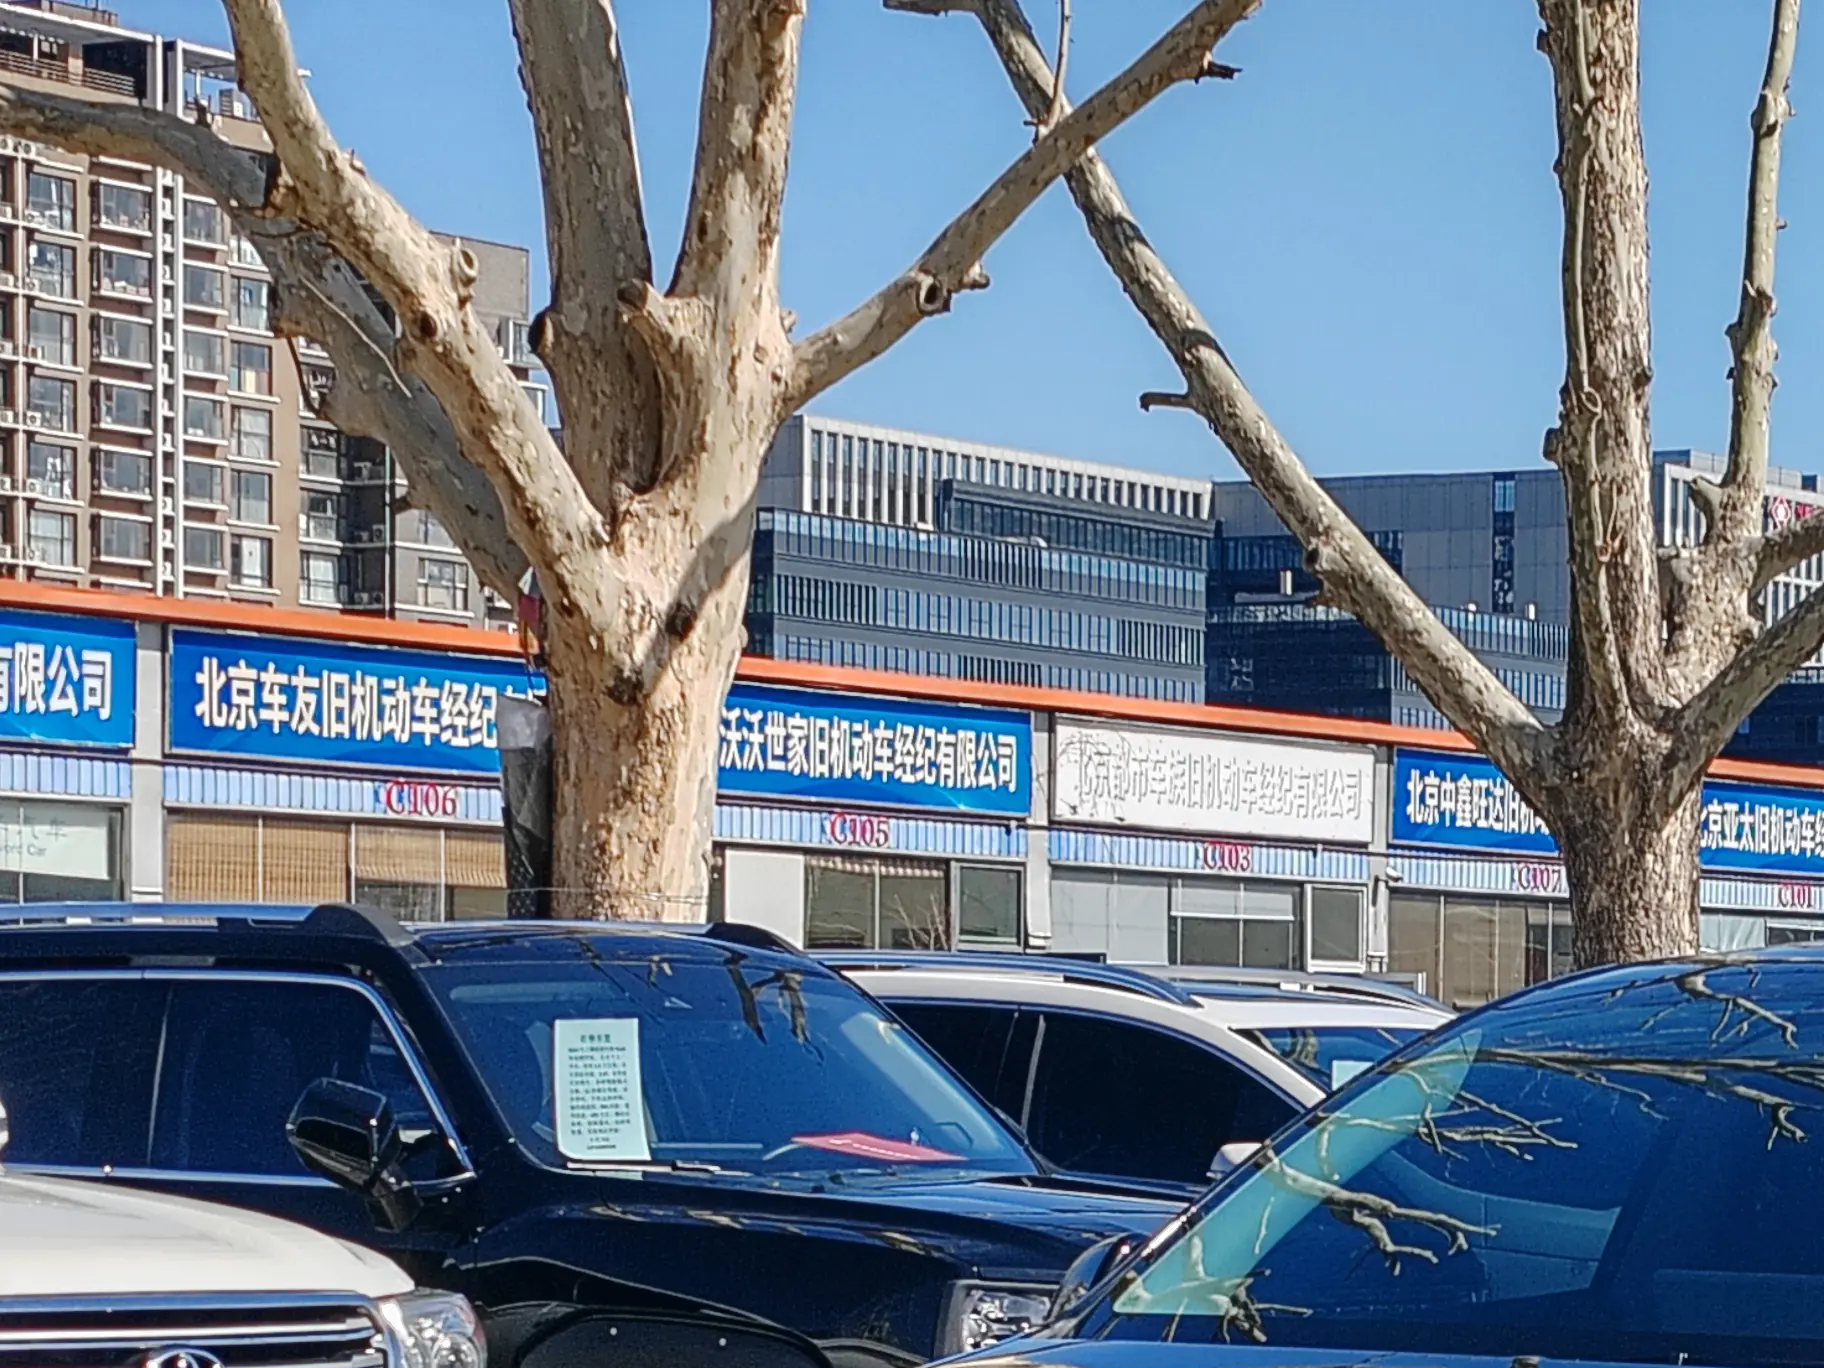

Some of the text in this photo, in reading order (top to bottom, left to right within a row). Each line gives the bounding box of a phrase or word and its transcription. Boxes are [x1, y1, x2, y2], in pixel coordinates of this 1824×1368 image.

[194, 656, 546, 748] 北京车友旧机动车经纪
[386, 777, 457, 816] C106
[831, 811, 890, 848] C105
[1778, 880, 1813, 909] C101
